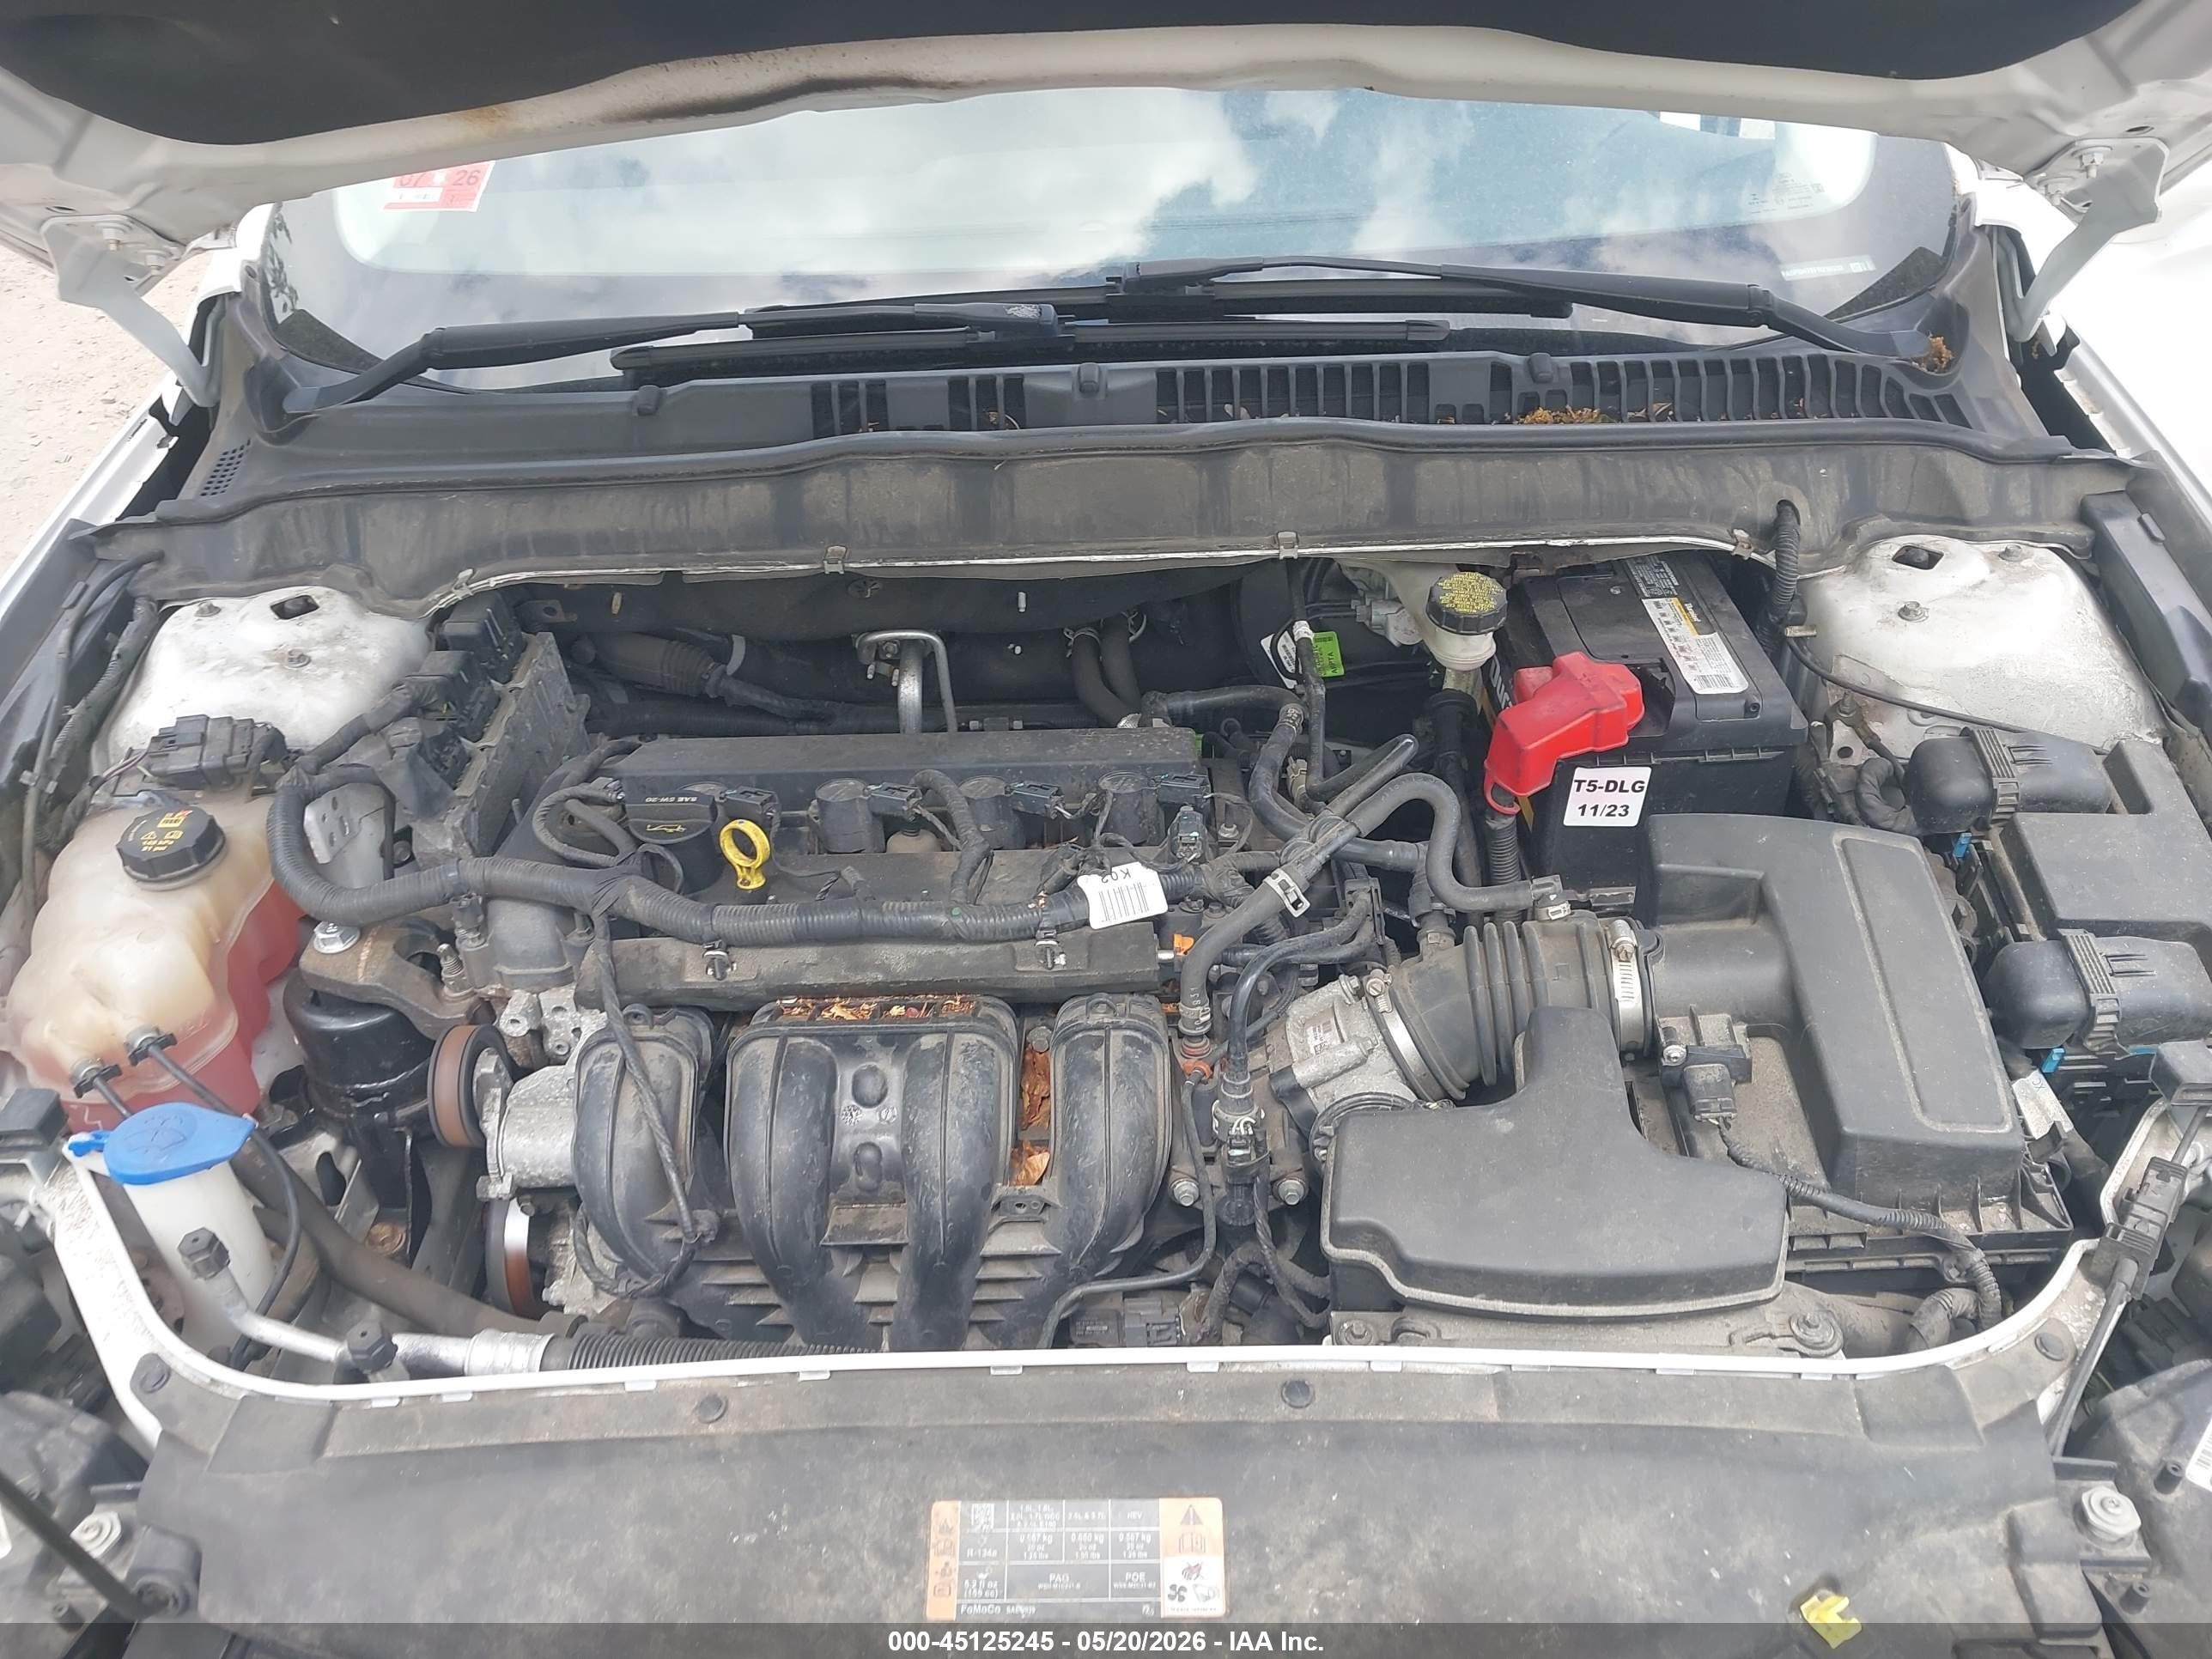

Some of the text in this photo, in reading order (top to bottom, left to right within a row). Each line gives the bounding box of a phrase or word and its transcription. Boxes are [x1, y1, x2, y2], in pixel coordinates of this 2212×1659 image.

[453, 170, 481, 185] 26
[1574, 780, 1645, 793] T5-DLG
[1578, 804, 1630, 817] 11/23
[1043, 1533, 1053, 1545] kg
[1094, 1532, 1104, 1545] kg
[1141, 1532, 1152, 1544] kg
[1049, 1573, 1069, 1582] PAG
[1126, 1571, 1146, 1581] POE
[961, 1605, 1000, 1614] FoMoCo
